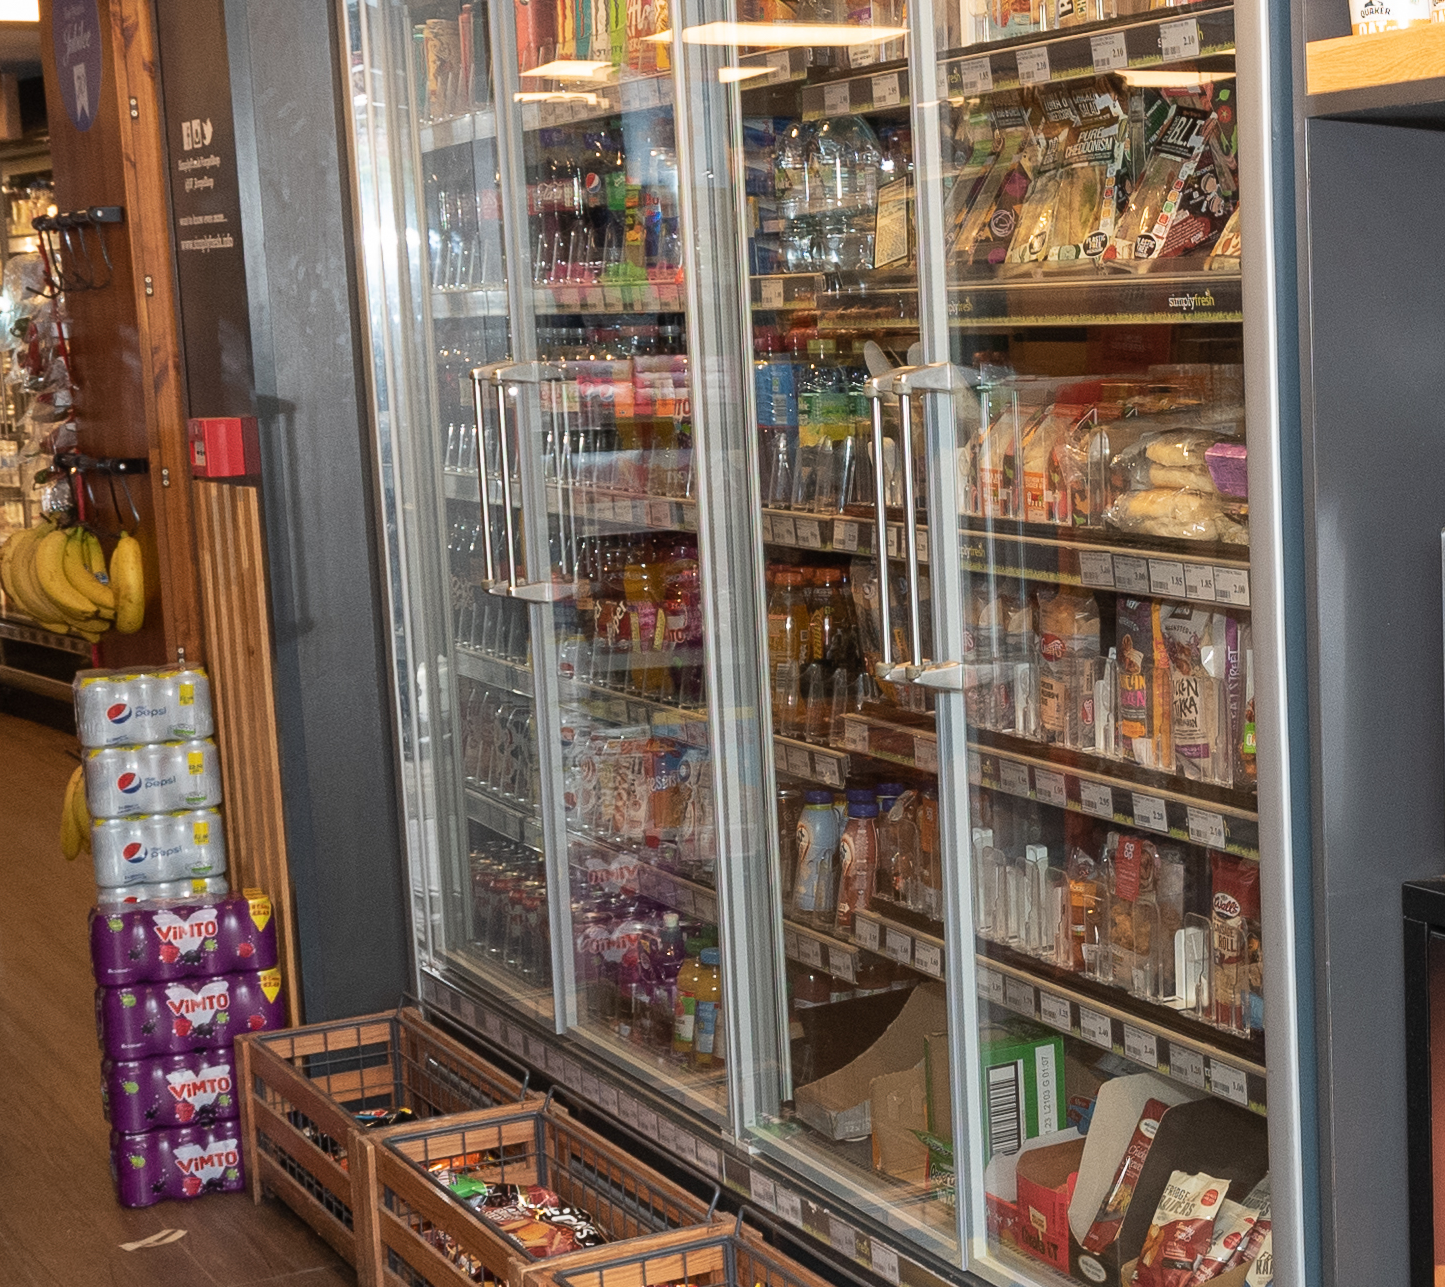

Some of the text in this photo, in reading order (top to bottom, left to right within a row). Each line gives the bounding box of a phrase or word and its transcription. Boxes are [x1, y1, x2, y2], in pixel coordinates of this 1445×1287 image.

[1077, 127, 1103, 144] PURE
[1064, 137, 1114, 159] CHEDDONISM
[144, 775, 177, 788] pepsi
